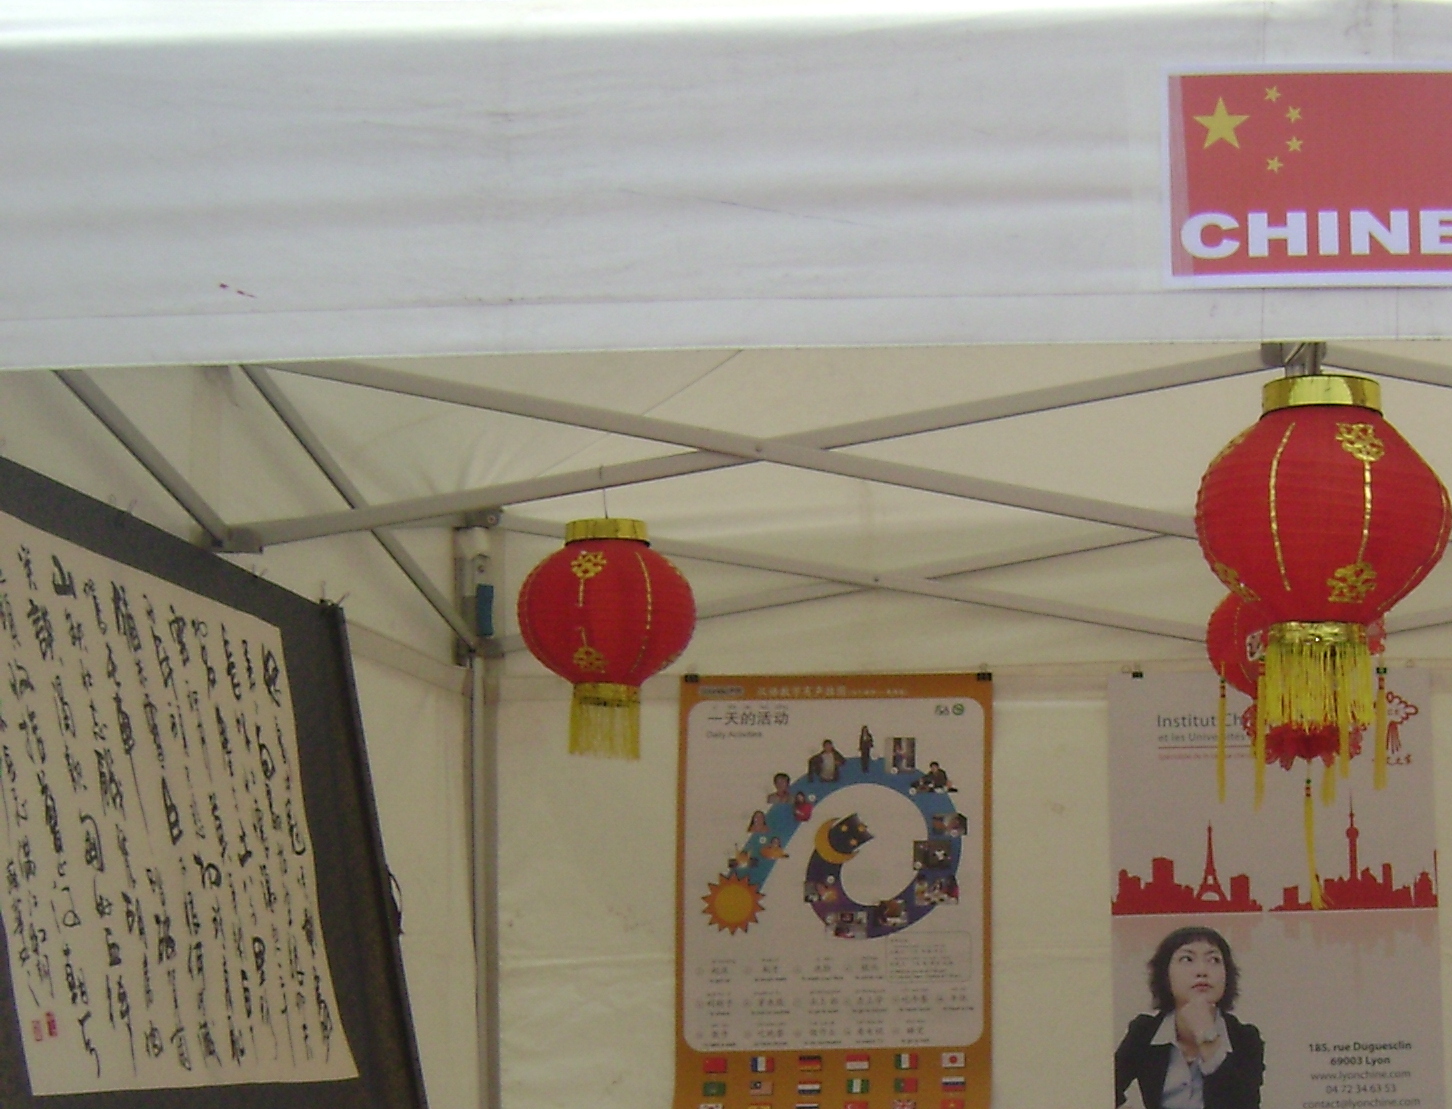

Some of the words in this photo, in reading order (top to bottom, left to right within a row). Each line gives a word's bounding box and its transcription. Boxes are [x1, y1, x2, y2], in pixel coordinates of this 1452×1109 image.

[707, 711, 789, 726] 一天的活动
[1157, 714, 1217, 728] Institut
[1309, 1043, 1331, 1053] 185,
[1333, 1043, 1351, 1052] rue
[1353, 1041, 1413, 1053] Duguesclin
[1330, 1056, 1363, 1066] 69003
[1365, 1056, 1391, 1067] Lyon
